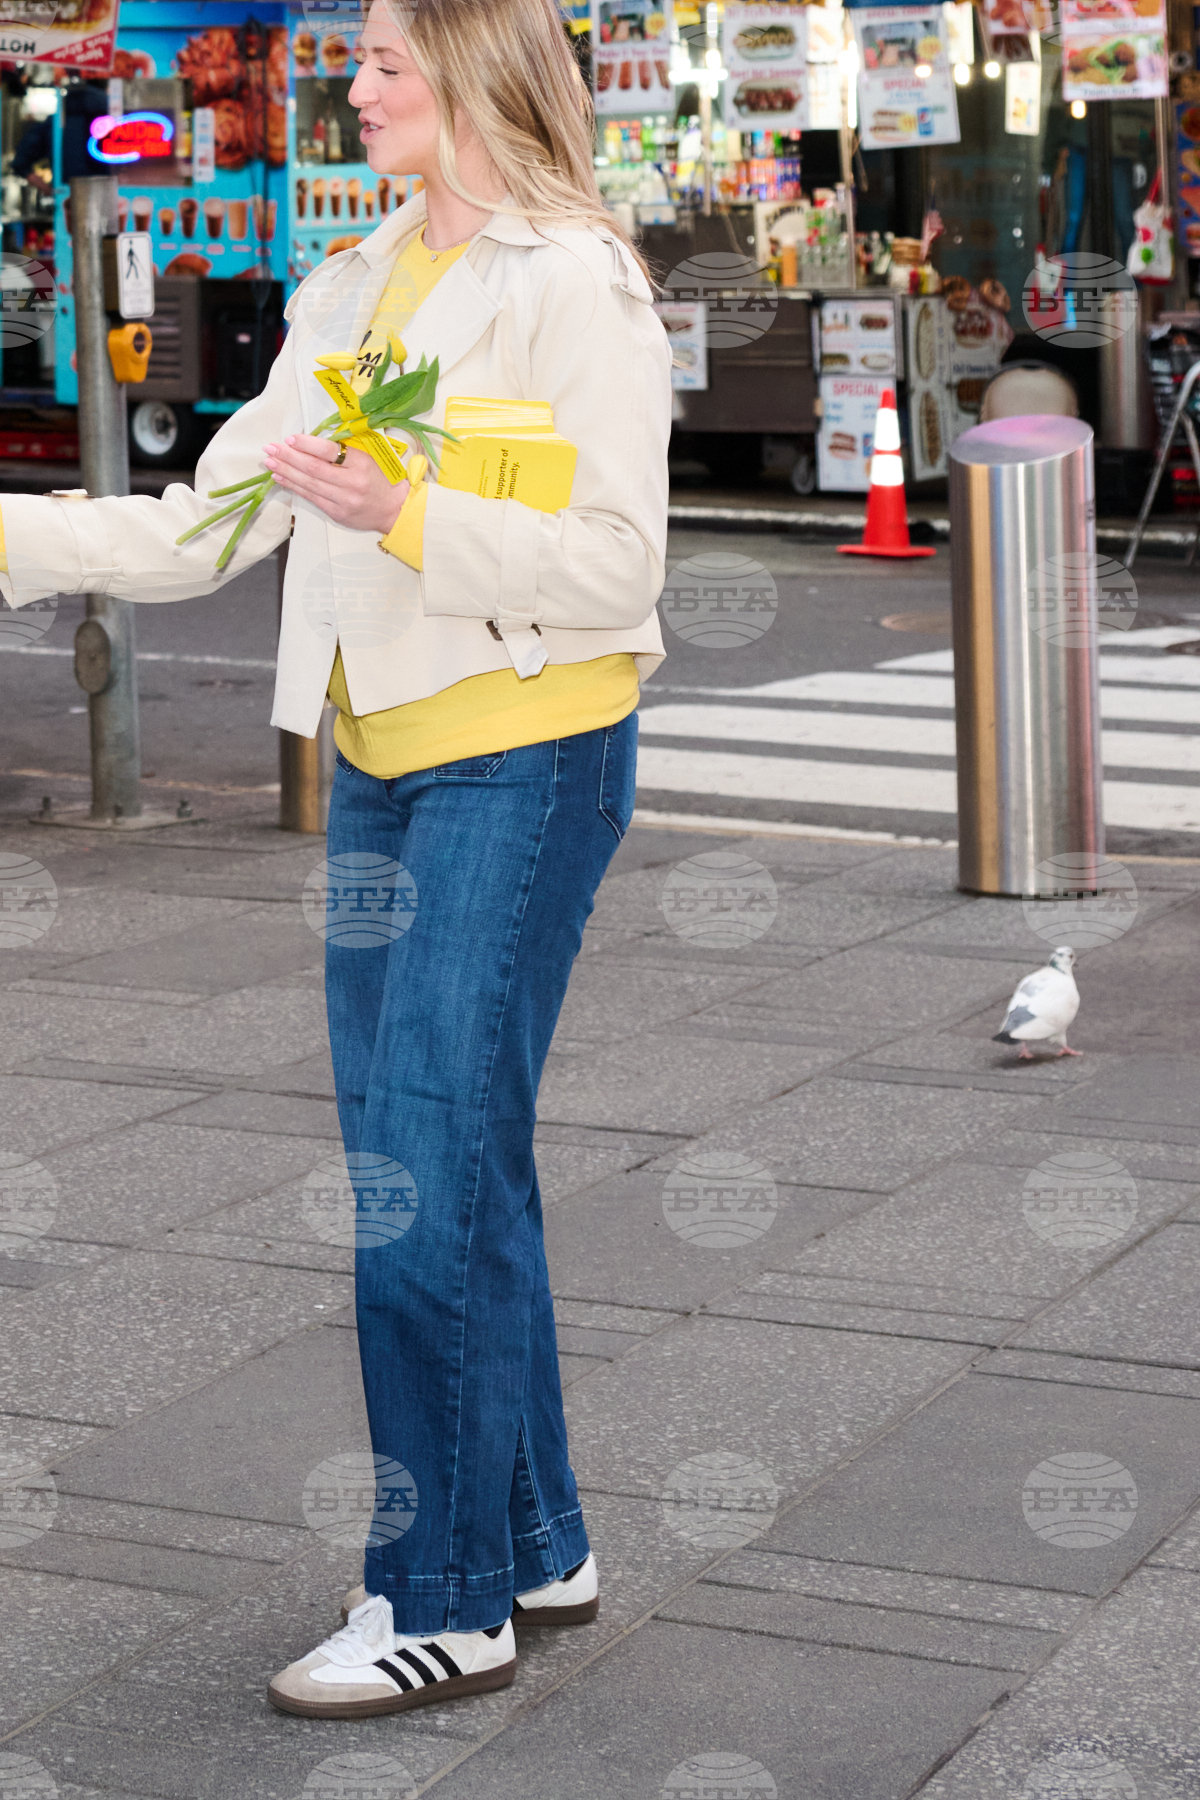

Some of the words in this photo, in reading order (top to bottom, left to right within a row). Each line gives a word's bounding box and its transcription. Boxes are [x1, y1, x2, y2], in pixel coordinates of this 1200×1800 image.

[501, 448, 509, 458] of
[496, 458, 507, 496] supporter
[508, 461, 520, 499] mmunity.
